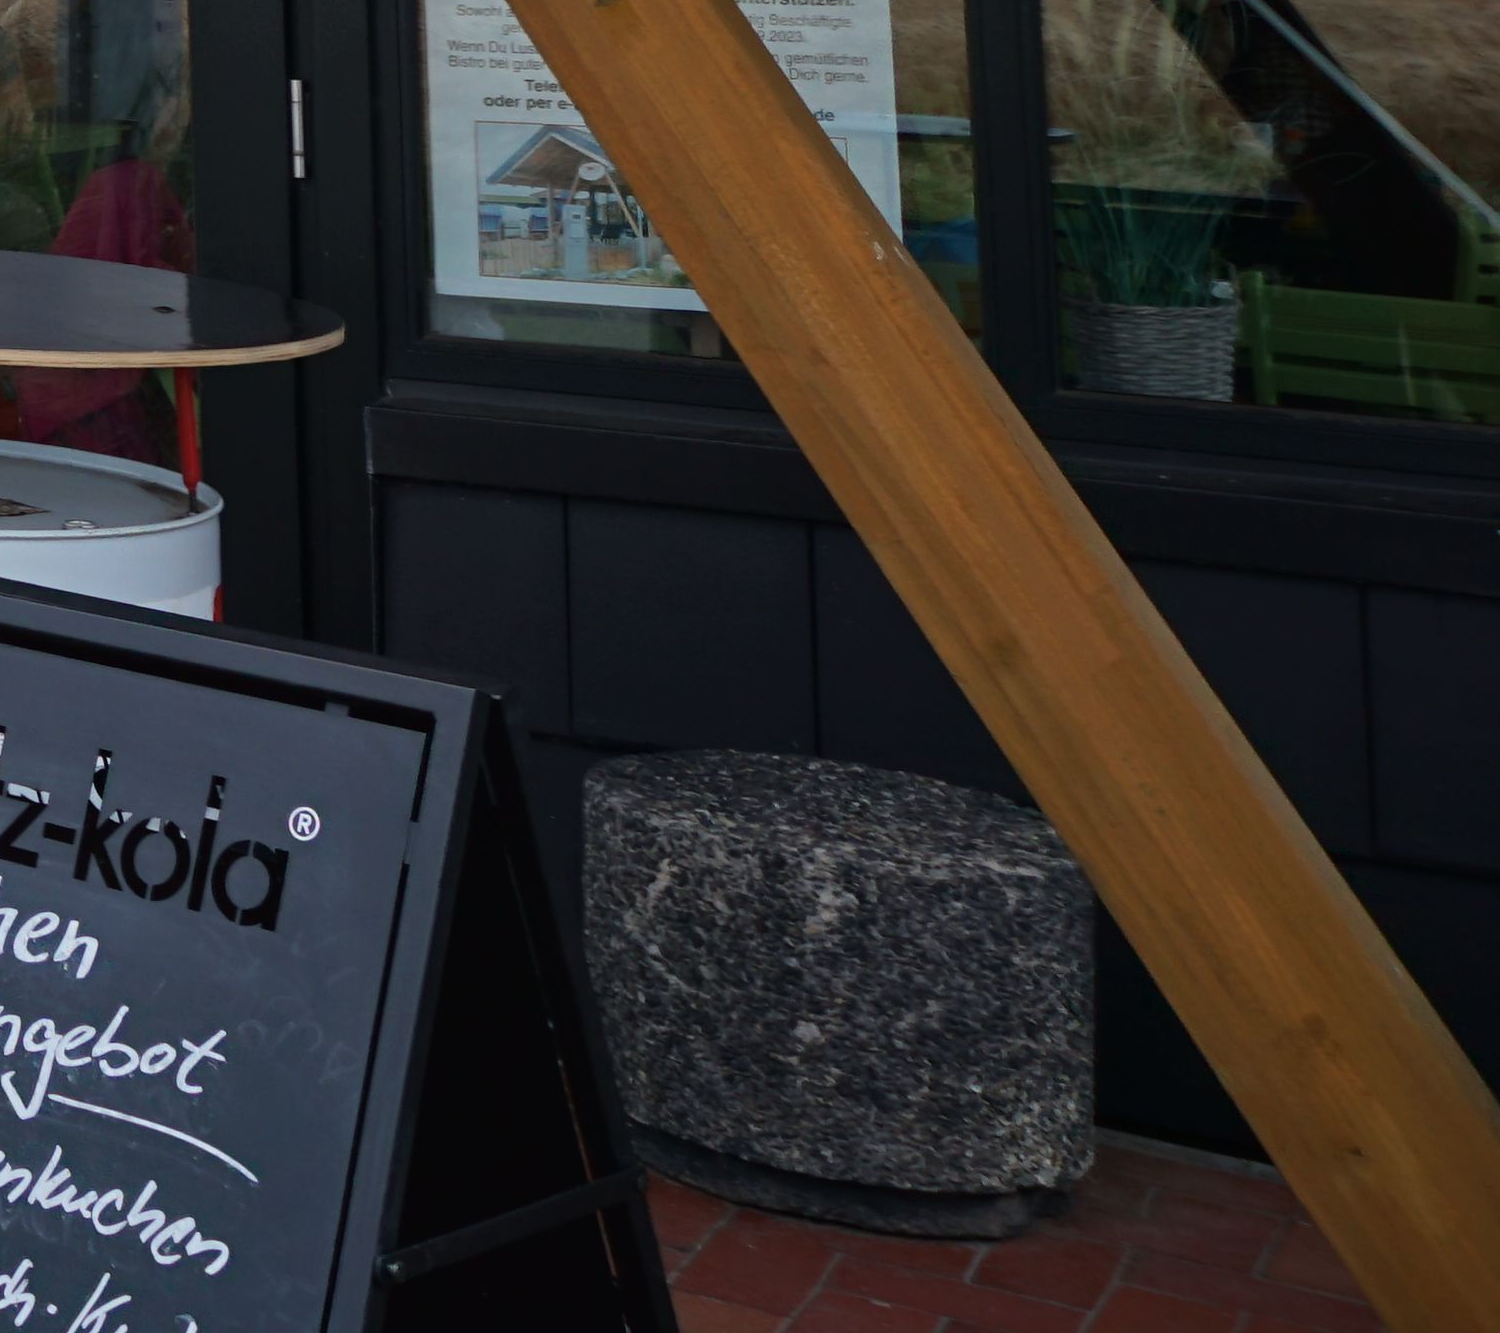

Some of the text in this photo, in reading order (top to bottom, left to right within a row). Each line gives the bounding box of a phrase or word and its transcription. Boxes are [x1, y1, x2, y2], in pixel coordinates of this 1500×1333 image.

[456, 4, 503, 18] Sowohl
[447, 40, 540, 55] Wenn Du Lus
[448, 55, 485, 69] Bistro
[489, 56, 509, 69] bei
[484, 95, 520, 109] oder
[526, 98, 552, 111] per
